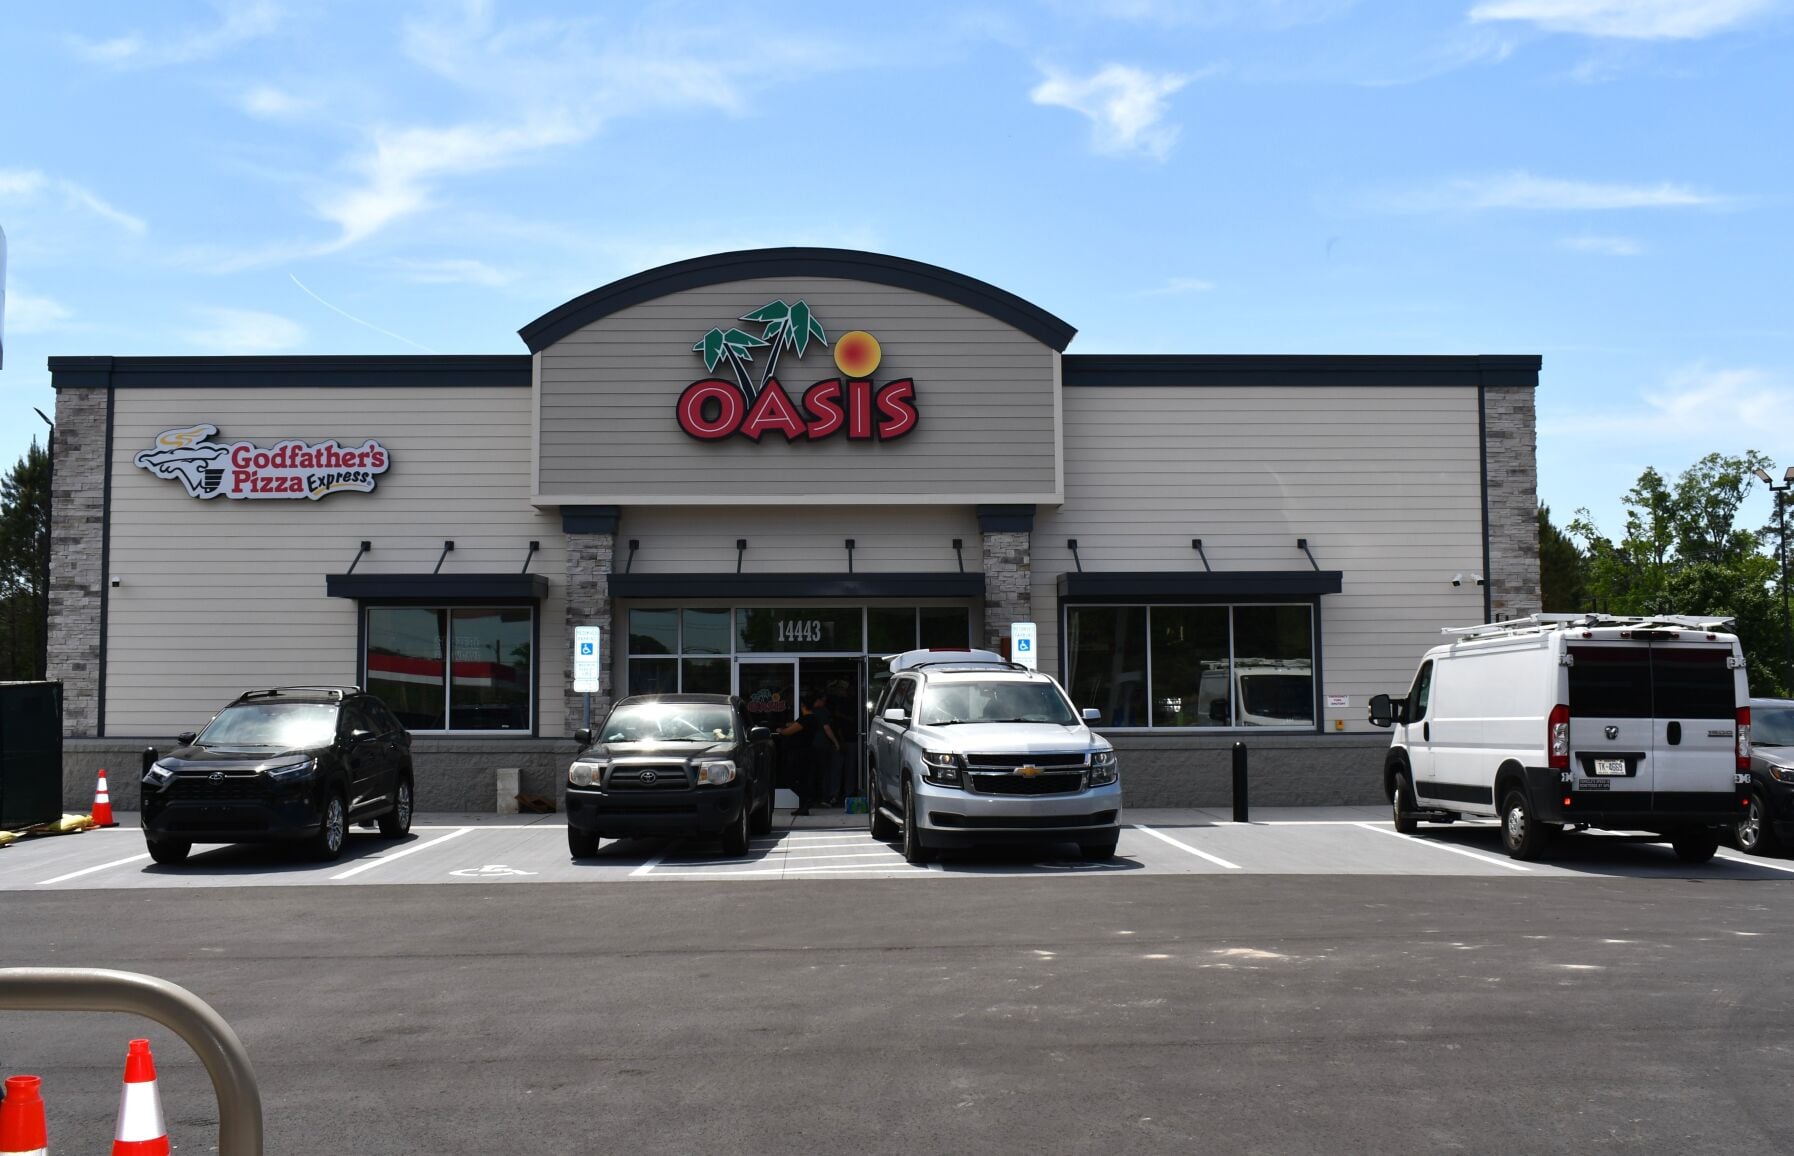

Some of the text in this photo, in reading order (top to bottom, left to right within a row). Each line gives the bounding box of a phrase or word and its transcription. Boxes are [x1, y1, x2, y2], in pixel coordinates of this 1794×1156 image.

[677, 378, 918, 443] OASIS
[231, 444, 385, 469] Godfather's
[231, 469, 368, 493] Pizza Express
[778, 620, 821, 641] 14443
